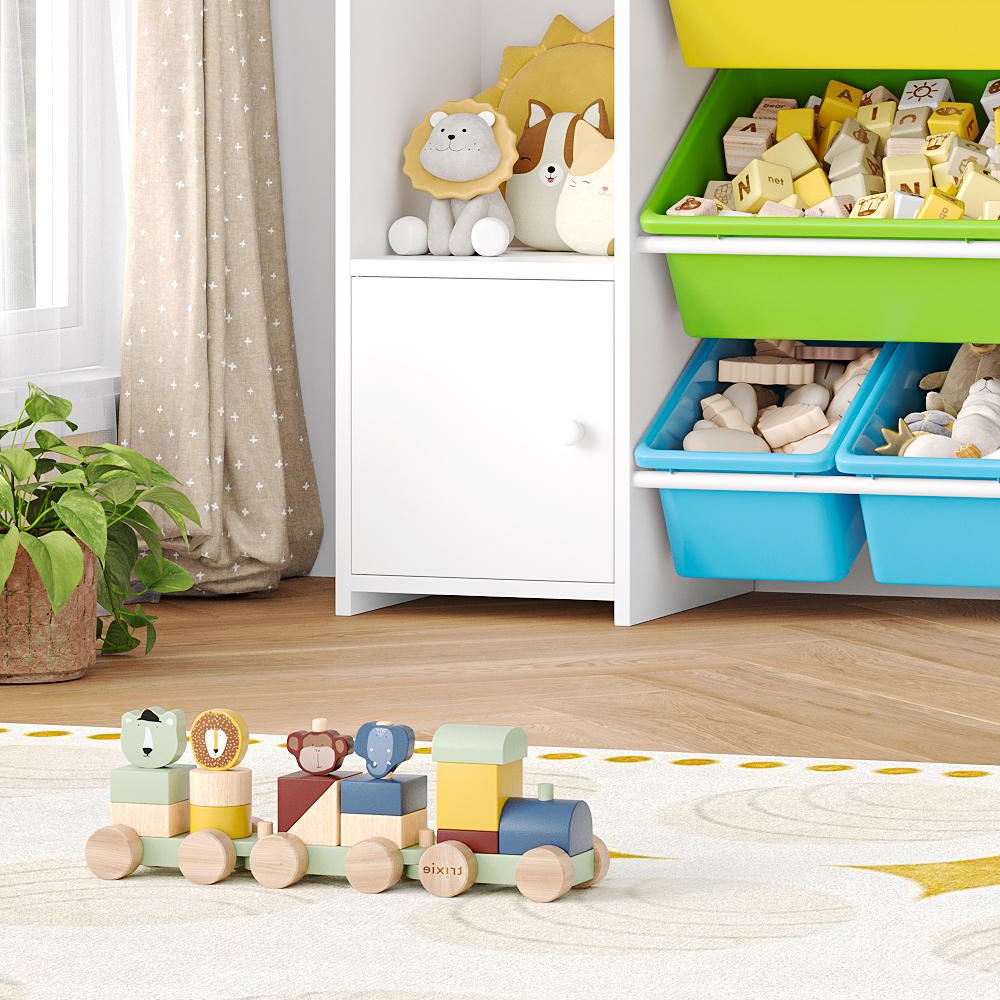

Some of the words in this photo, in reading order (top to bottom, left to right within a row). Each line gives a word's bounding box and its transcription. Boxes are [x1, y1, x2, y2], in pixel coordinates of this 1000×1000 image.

[836, 89, 853, 103] A
[738, 174, 751, 201] N
[768, 176, 784, 186] net
